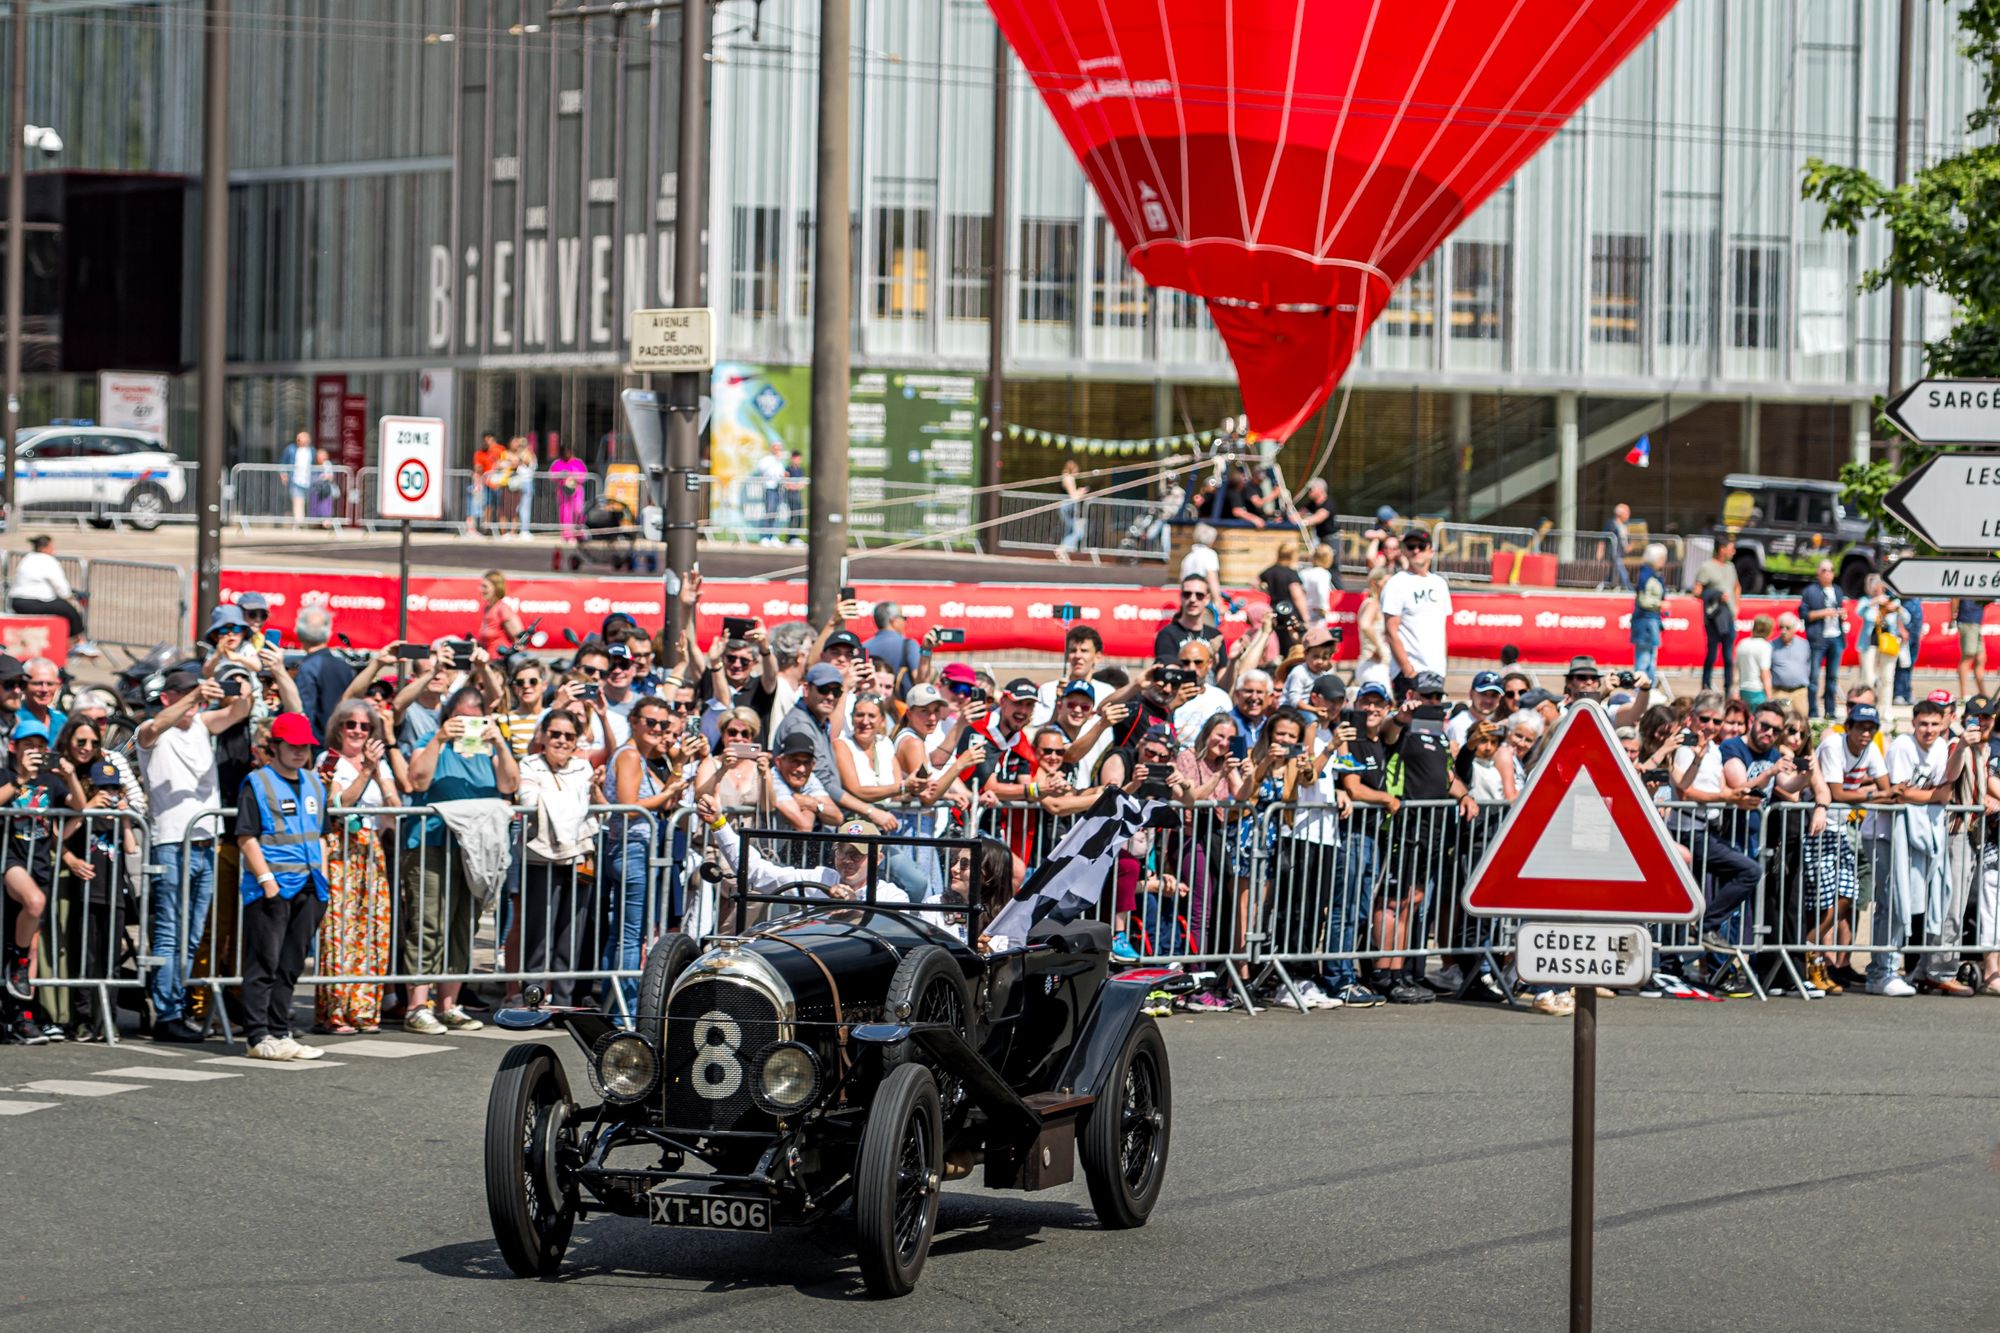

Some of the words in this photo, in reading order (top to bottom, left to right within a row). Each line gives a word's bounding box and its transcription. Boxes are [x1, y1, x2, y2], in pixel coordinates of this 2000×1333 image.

[652, 316, 689, 328] AVENUE
[663, 331, 677, 342] DE
[639, 345, 703, 357] PADERBORN
[397, 431, 430, 446] ZONE
[402, 470, 423, 490] 30
[1534, 930, 1596, 951] CÉDEZ
[1608, 936, 1629, 952] LE
[1536, 957, 1626, 976] PASSAGE
[691, 1010, 743, 1099] 8
[652, 1195, 766, 1228] XT-1606
